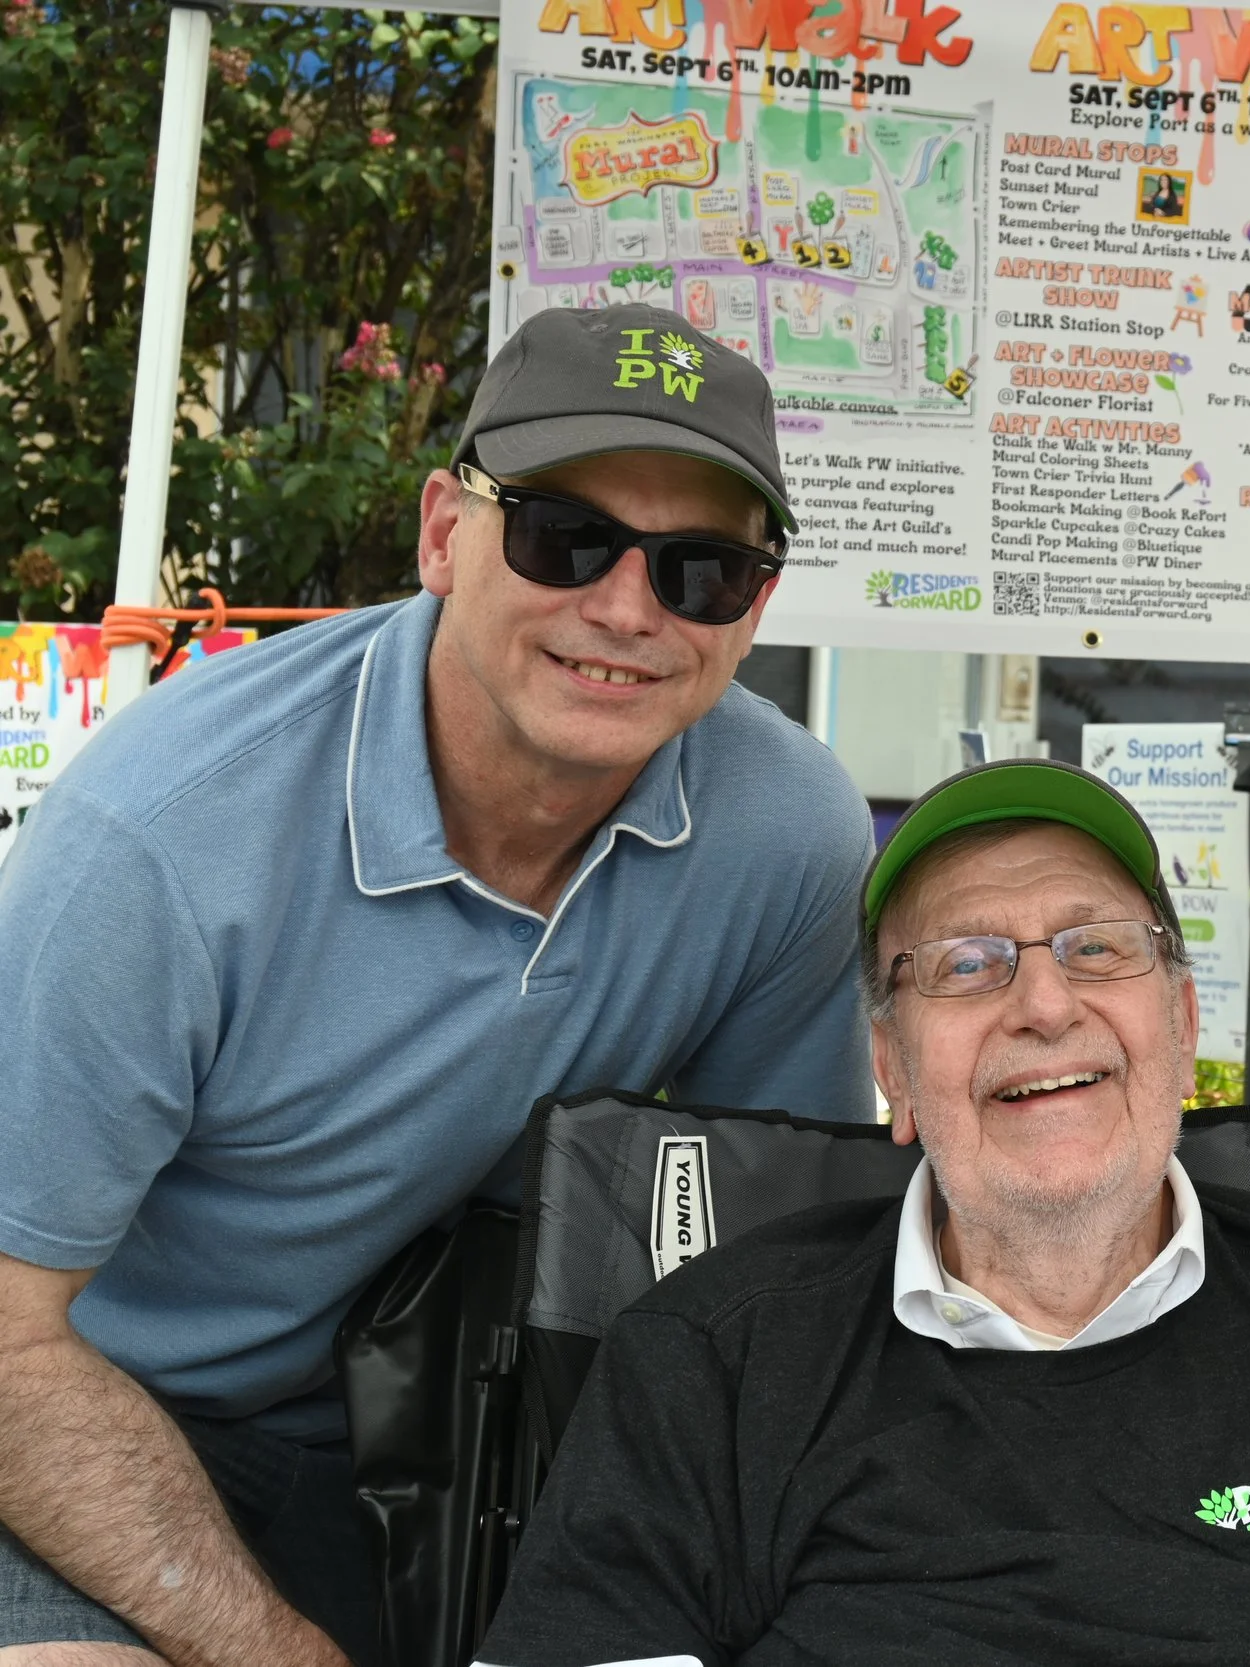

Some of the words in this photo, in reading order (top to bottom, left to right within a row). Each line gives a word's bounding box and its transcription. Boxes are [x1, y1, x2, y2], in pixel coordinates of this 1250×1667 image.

[1030, 3, 1194, 86] ART
[580, 46, 637, 75] SAT,
[1068, 82, 1123, 110] SAT,
[1069, 106, 1144, 130] Explore
[1149, 113, 1191, 132] Port
[1196, 120, 1217, 134] as
[1221, 122, 1234, 136] a
[574, 136, 700, 181] Mural
[1004, 133, 1092, 159] MURAL
[1097, 140, 1178, 166] STOPS
[1000, 158, 1031, 175] Post
[1034, 161, 1072, 178] Card
[1075, 164, 1121, 181] Mural
[999, 177, 1050, 194] Sunset
[1053, 181, 1099, 198] Mural
[998, 195, 1038, 212] Town
[1041, 198, 1081, 215] Crier
[998, 213, 1100, 237] Remembering
[1104, 221, 1127, 236] the
[1131, 222, 1232, 243] Unforgettable
[1042, 285, 1119, 310] SHOW
[995, 310, 1055, 330] @LIRR
[1059, 314, 1121, 334] Station
[1126, 319, 1165, 341] Stop
[619, 328, 654, 355] I
[995, 341, 1046, 364] ART
[613, 358, 704, 403] PW
[839, 402, 899, 417] canvas.
[997, 388, 1093, 409] @Falconer
[1097, 394, 1154, 413] Florist
[990, 413, 1041, 437] ART
[993, 435, 1033, 451] Chalk
[1037, 436, 1059, 451] the
[1062, 438, 1098, 453] Walk
[1118, 442, 1141, 455] Mr.
[1146, 444, 1192, 460] Manny
[784, 451, 821, 468] Let's
[824, 453, 863, 470] Walk
[866, 456, 892, 472] PW
[896, 458, 965, 476] initiative.
[800, 475, 852, 492] purple
[855, 477, 886, 492] and
[889, 479, 955, 496] explores
[804, 497, 858, 511] canvas
[862, 497, 935, 516] featuring
[795, 515, 840, 531] roject,
[844, 516, 868, 531] the
[871, 518, 897, 533] Art
[901, 519, 952, 536] Guild's
[819, 535, 839, 550] lot
[842, 538, 873, 552] and
[876, 540, 918, 554] much
[922, 542, 967, 556] more!
[784, 555, 839, 568] member
[893, 573, 978, 597] RESIDENTS
[893, 587, 981, 611] FORWARD
[1127, 738, 1204, 762] Support
[1108, 767, 1142, 787] Our
[1148, 767, 1227, 788] Mission!
[677, 1160, 691, 1246] YOUNG
